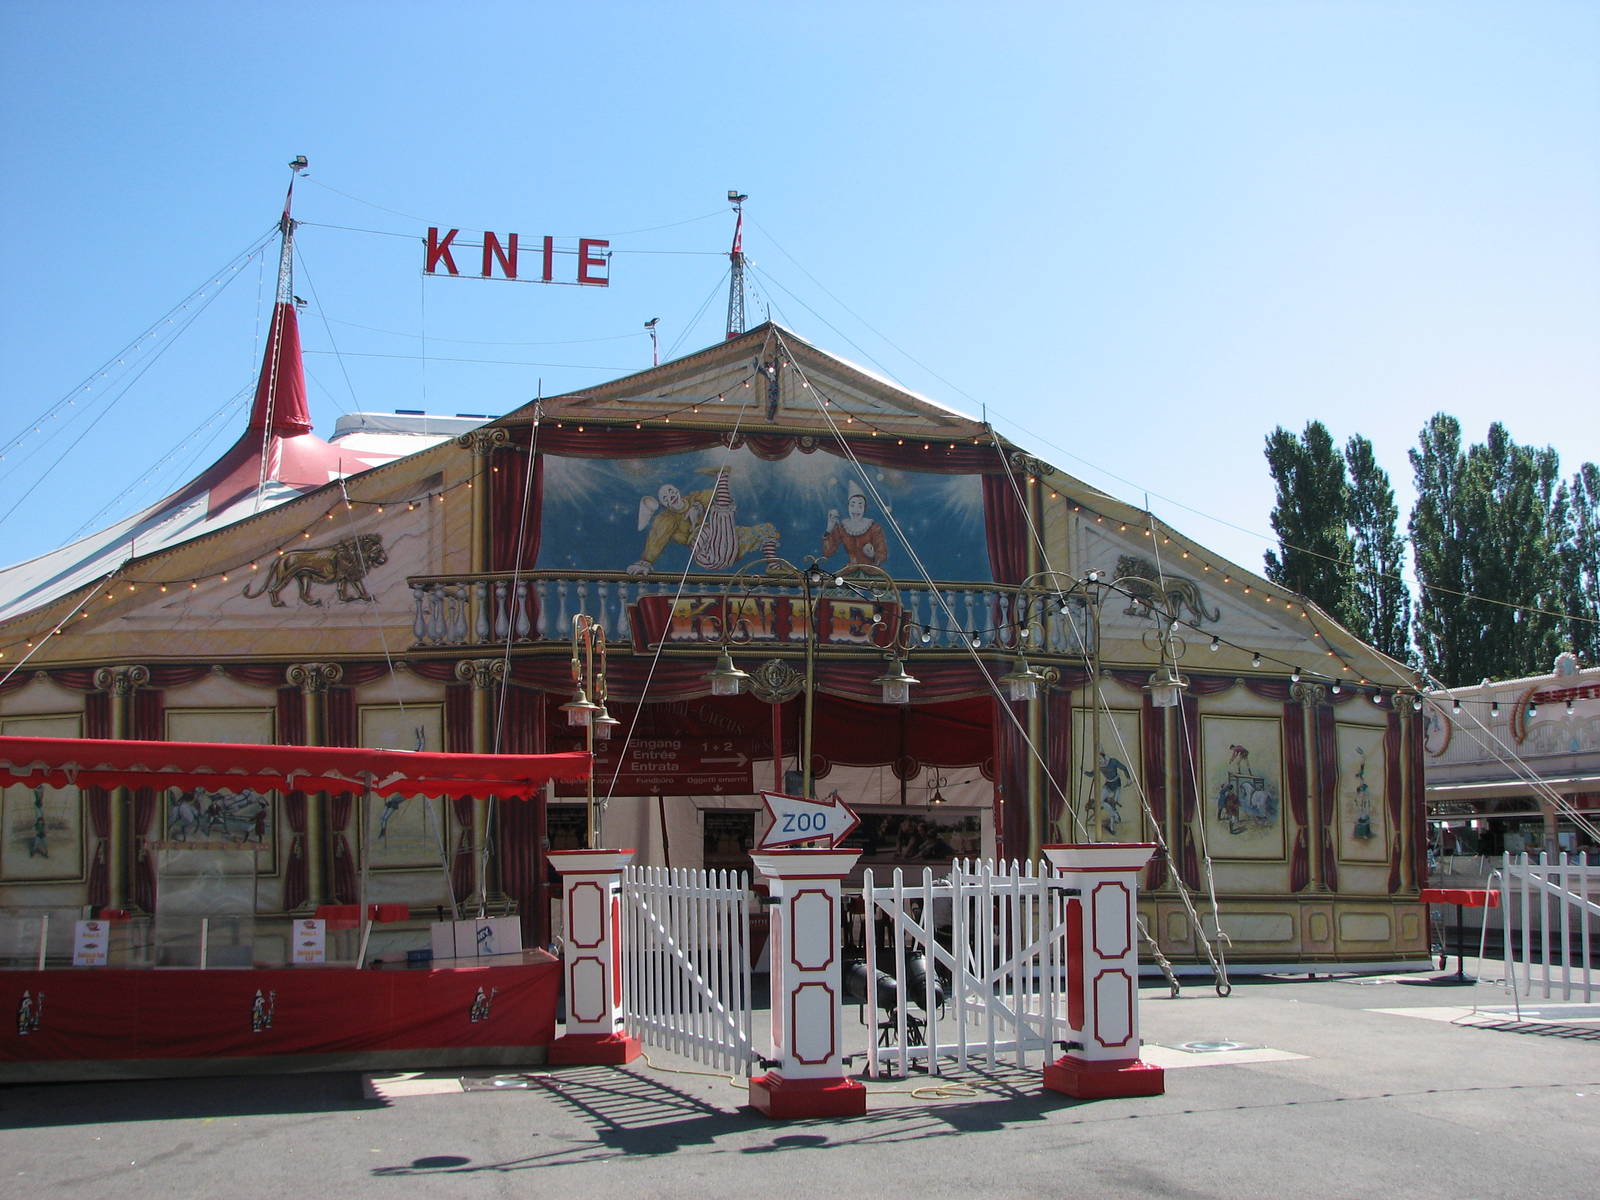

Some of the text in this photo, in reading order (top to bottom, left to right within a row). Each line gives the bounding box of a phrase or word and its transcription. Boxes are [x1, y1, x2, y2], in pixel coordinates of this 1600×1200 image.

[426, 227, 609, 283] KNIE
[668, 598, 873, 643] KNIE
[600, 742, 608, 752] 3
[629, 739, 681, 750] Eingang
[702, 743, 708, 752] 1
[724, 742, 733, 751] 2
[633, 749, 677, 760] Entrée
[631, 762, 679, 771] Entrata
[782, 813, 826, 832] ZOO
